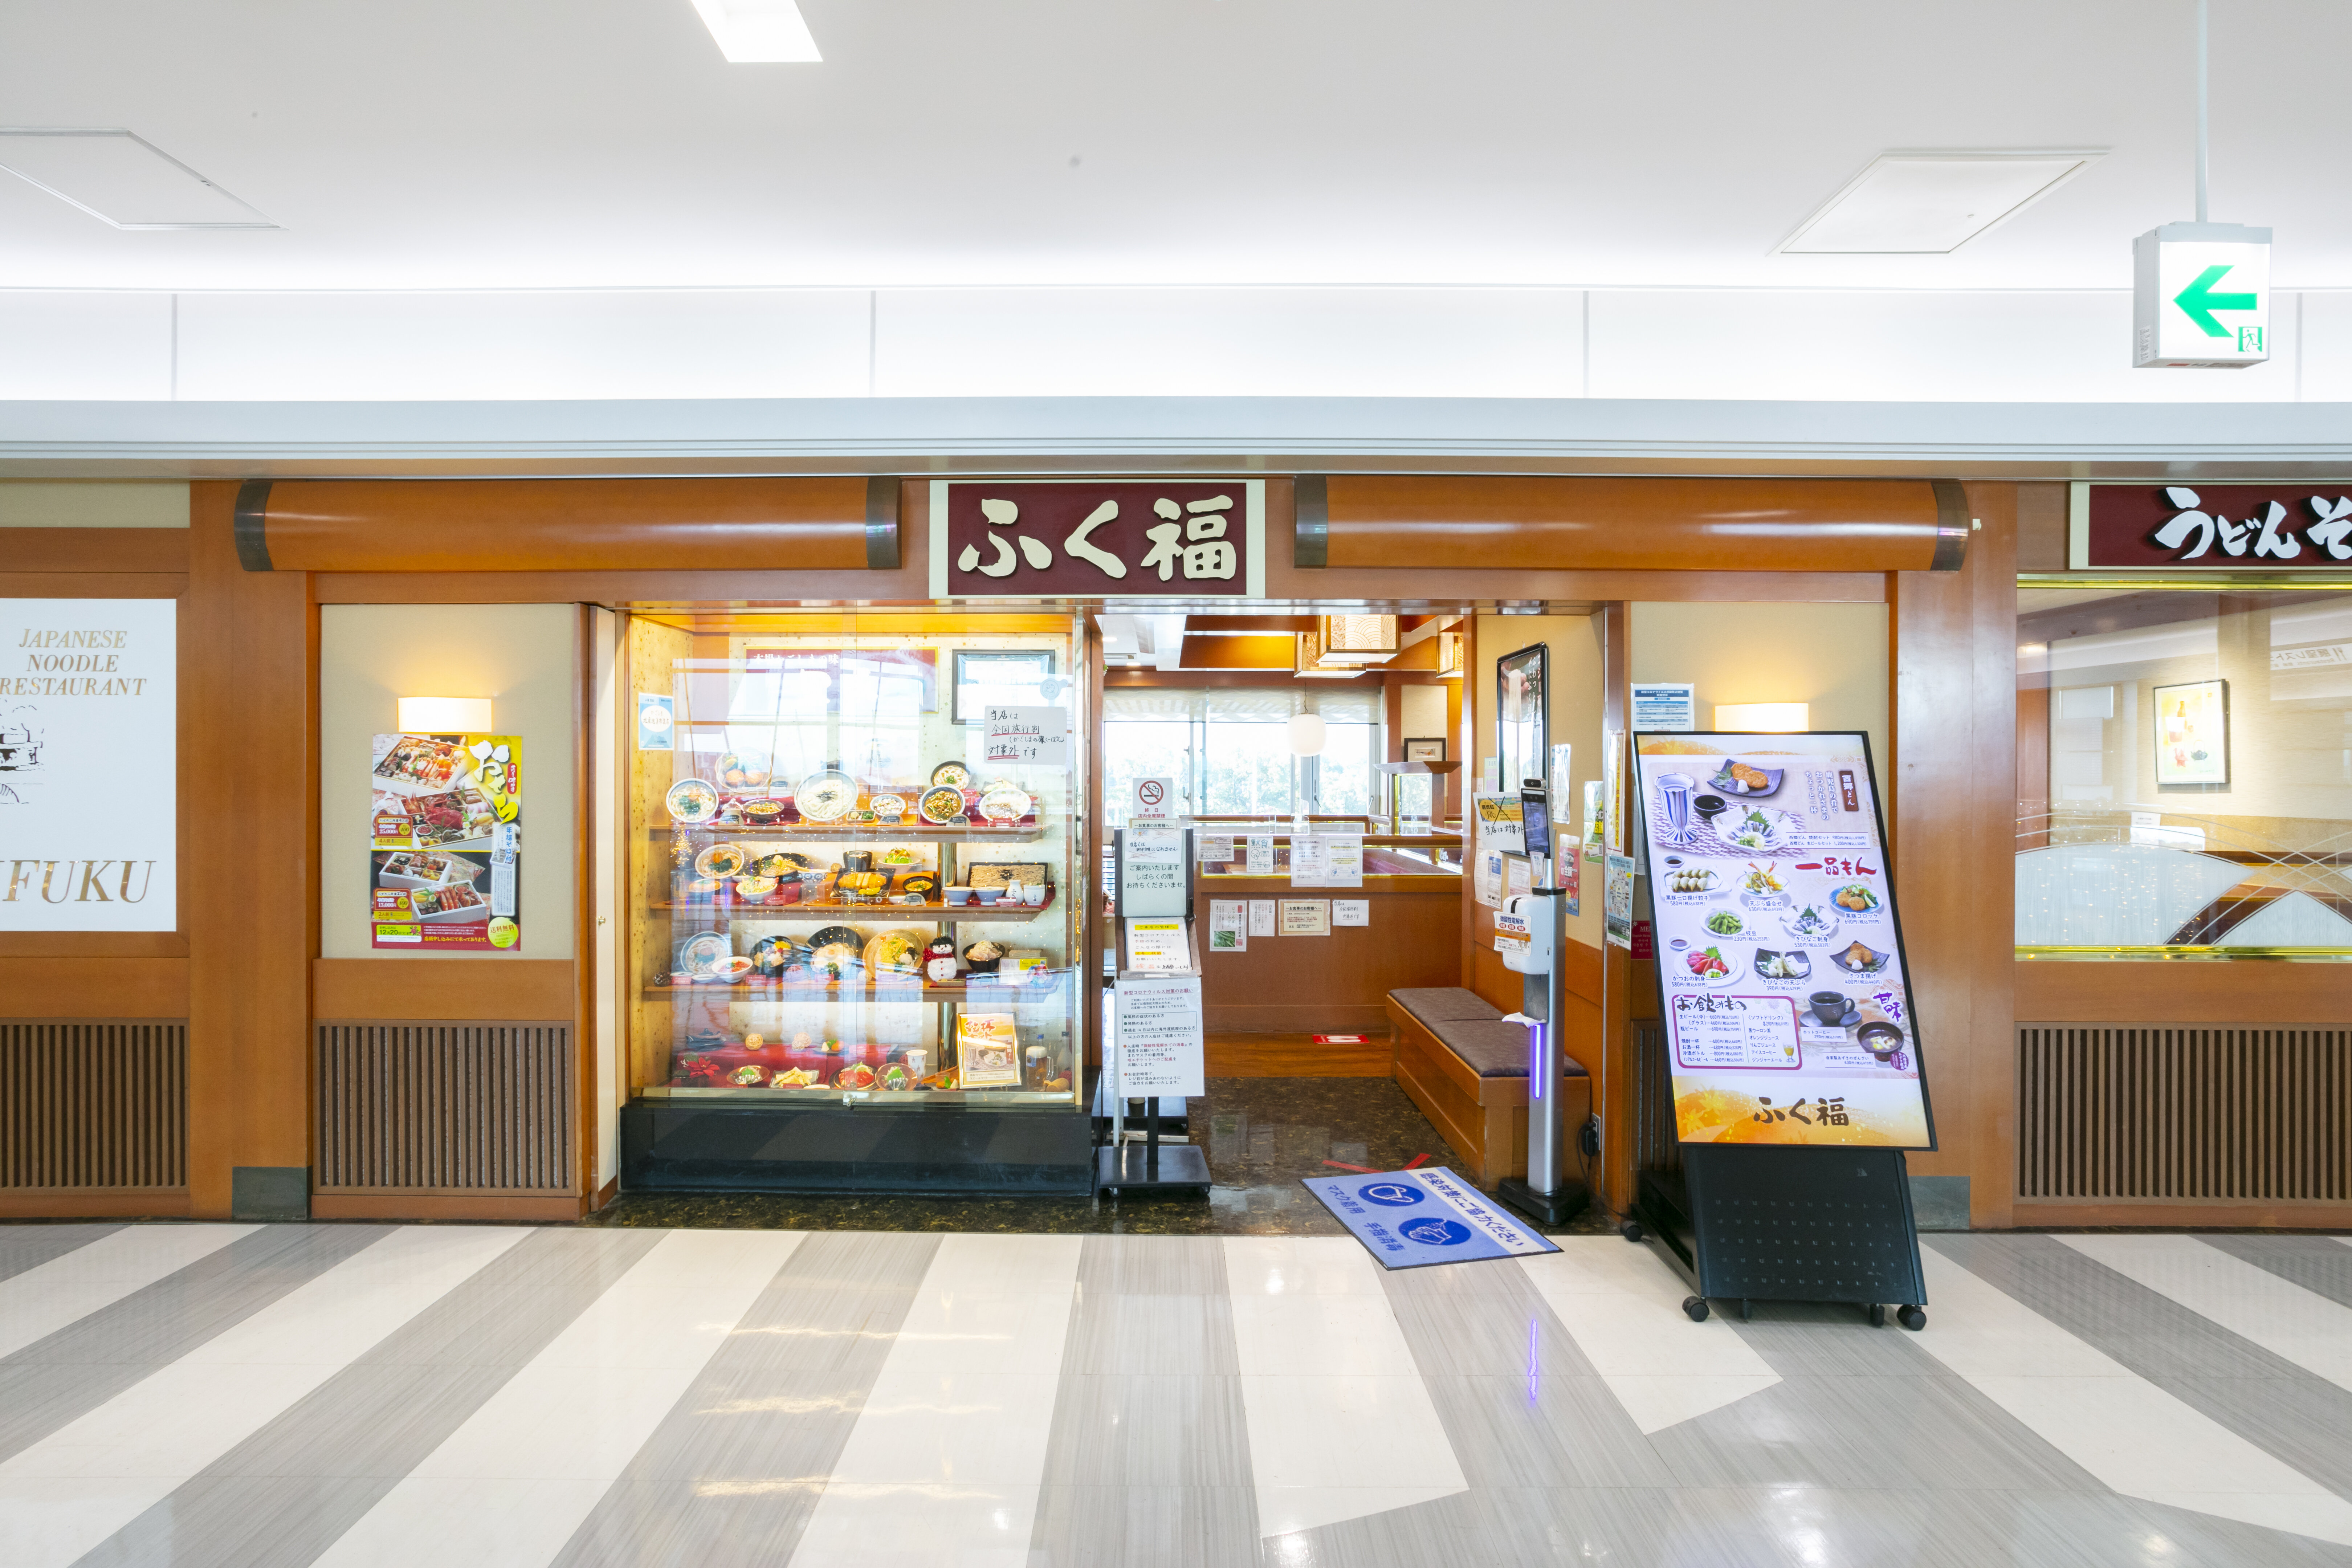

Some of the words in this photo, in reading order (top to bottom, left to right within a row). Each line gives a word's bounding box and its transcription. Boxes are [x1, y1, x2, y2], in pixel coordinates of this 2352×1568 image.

[957, 494, 1236, 581] ふく福
[19, 628, 127, 649] JAPANESE
[27, 655, 118, 672] NOODLE
[0, 678, 147, 696] RESTAURANT
[990, 709, 1018, 721] 当店は
[991, 724, 1039, 734] 全国旅行割
[1805, 771, 1818, 814] ちょっと一杯
[1815, 771, 1829, 820] おつかれさまの
[1842, 775, 1855, 806] 西郷どん
[1795, 857, 1877, 875] 一品もん
[0, 860, 156, 903] FUKU
[490, 924, 514, 933] 送料無料
[1676, 993, 1747, 1013] お飲みもの
[965, 1019, 996, 1033] 乾杯
[1753, 1096, 1849, 1126] ふく福
[1327, 1185, 1366, 1214] マスク着用
[1419, 1173, 1524, 1246] 感染対策にご協力ください
[1363, 1222, 1406, 1251] 手指消毒
